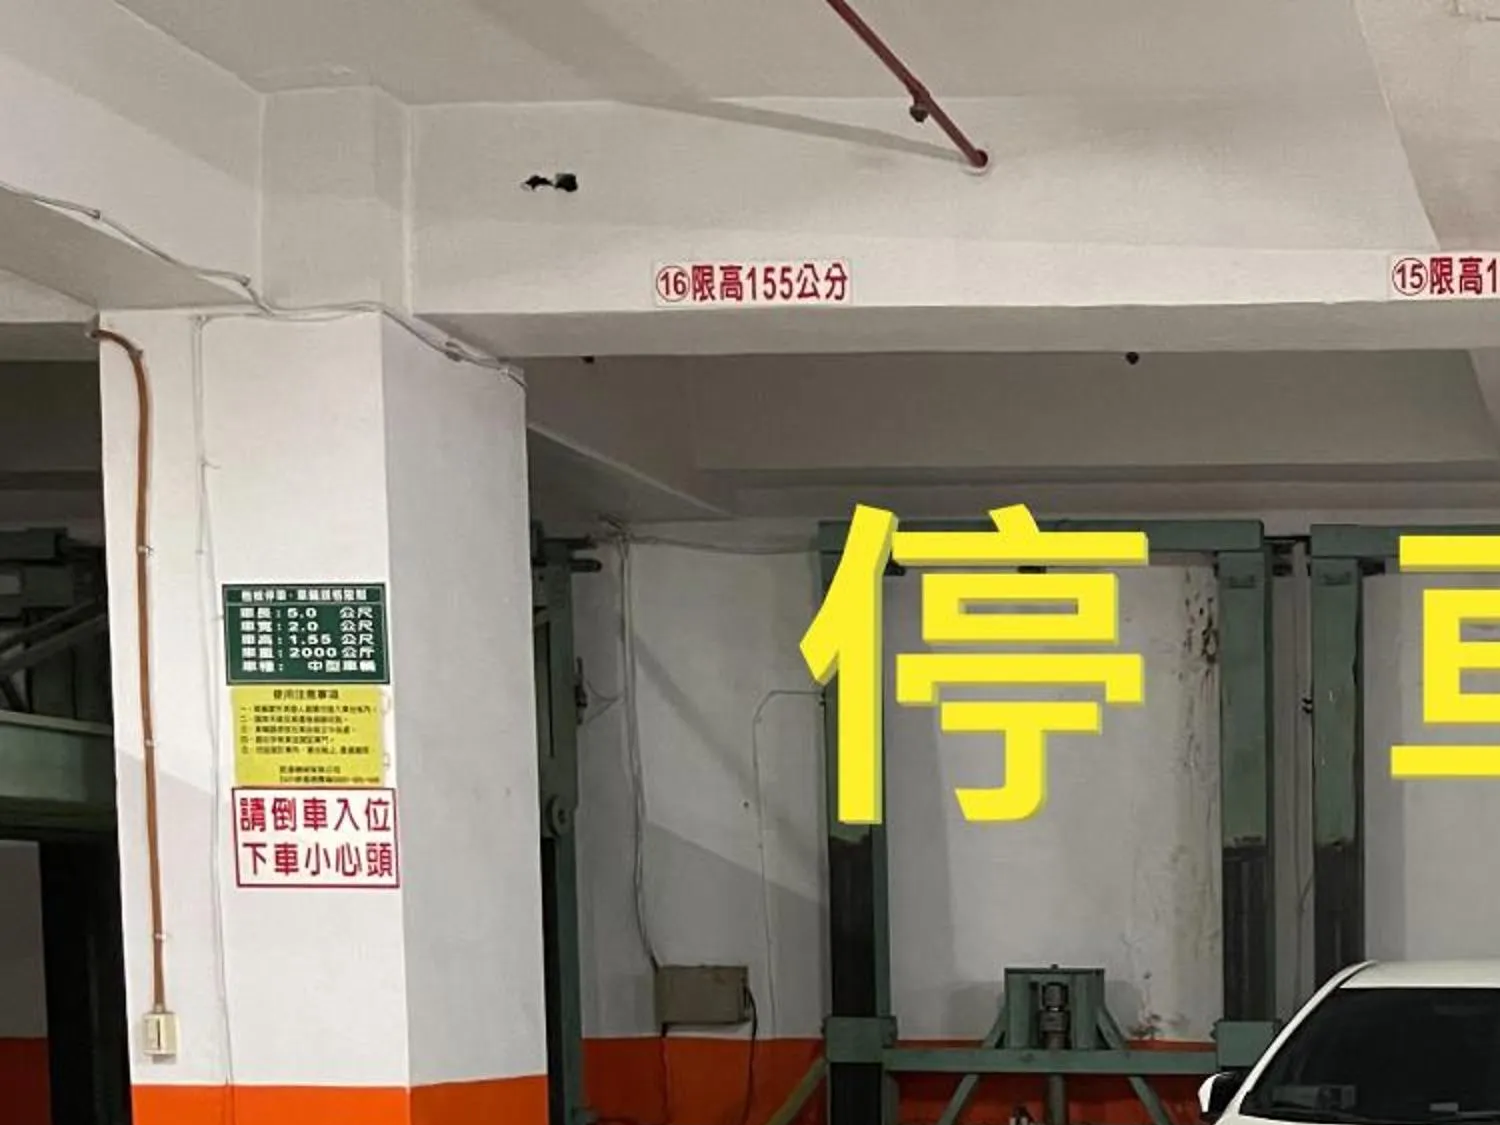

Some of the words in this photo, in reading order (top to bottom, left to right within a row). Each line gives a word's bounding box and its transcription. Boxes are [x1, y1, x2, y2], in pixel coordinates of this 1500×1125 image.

[239, 797, 391, 833] 請倒車入位
[242, 842, 393, 877] 下車小心頭
